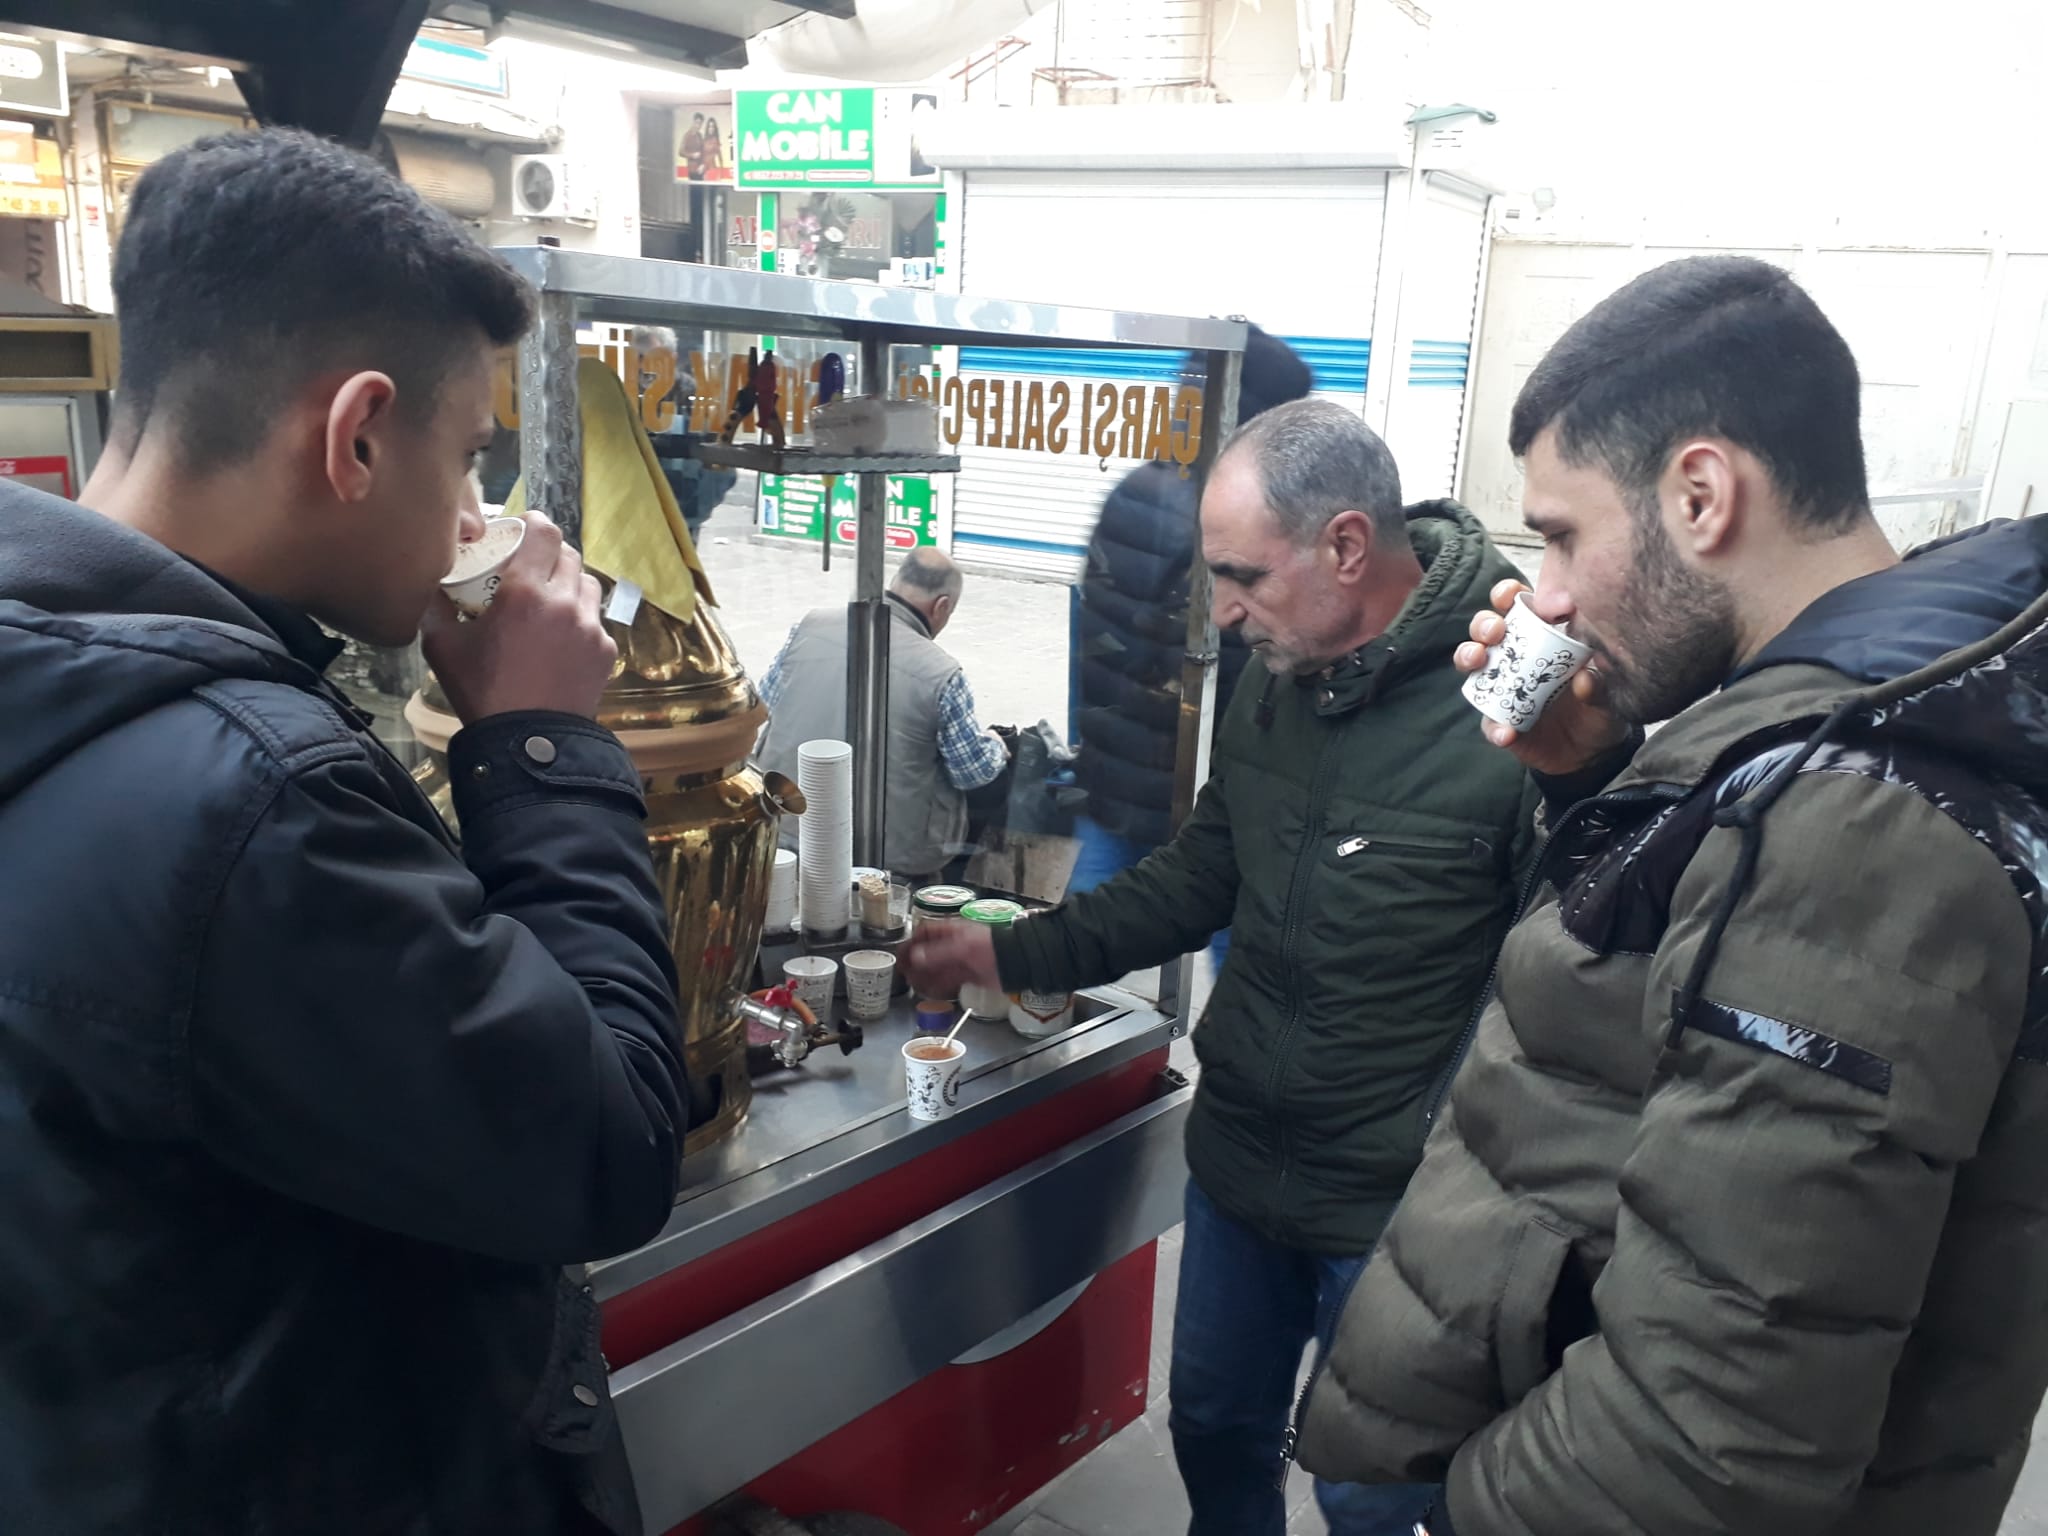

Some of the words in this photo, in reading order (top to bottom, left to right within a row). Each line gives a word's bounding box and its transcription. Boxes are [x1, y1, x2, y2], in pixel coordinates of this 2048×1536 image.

[766, 91, 843, 125] CAN
[741, 124, 870, 161] MOBİLE
[831, 499, 922, 527] MİLE
